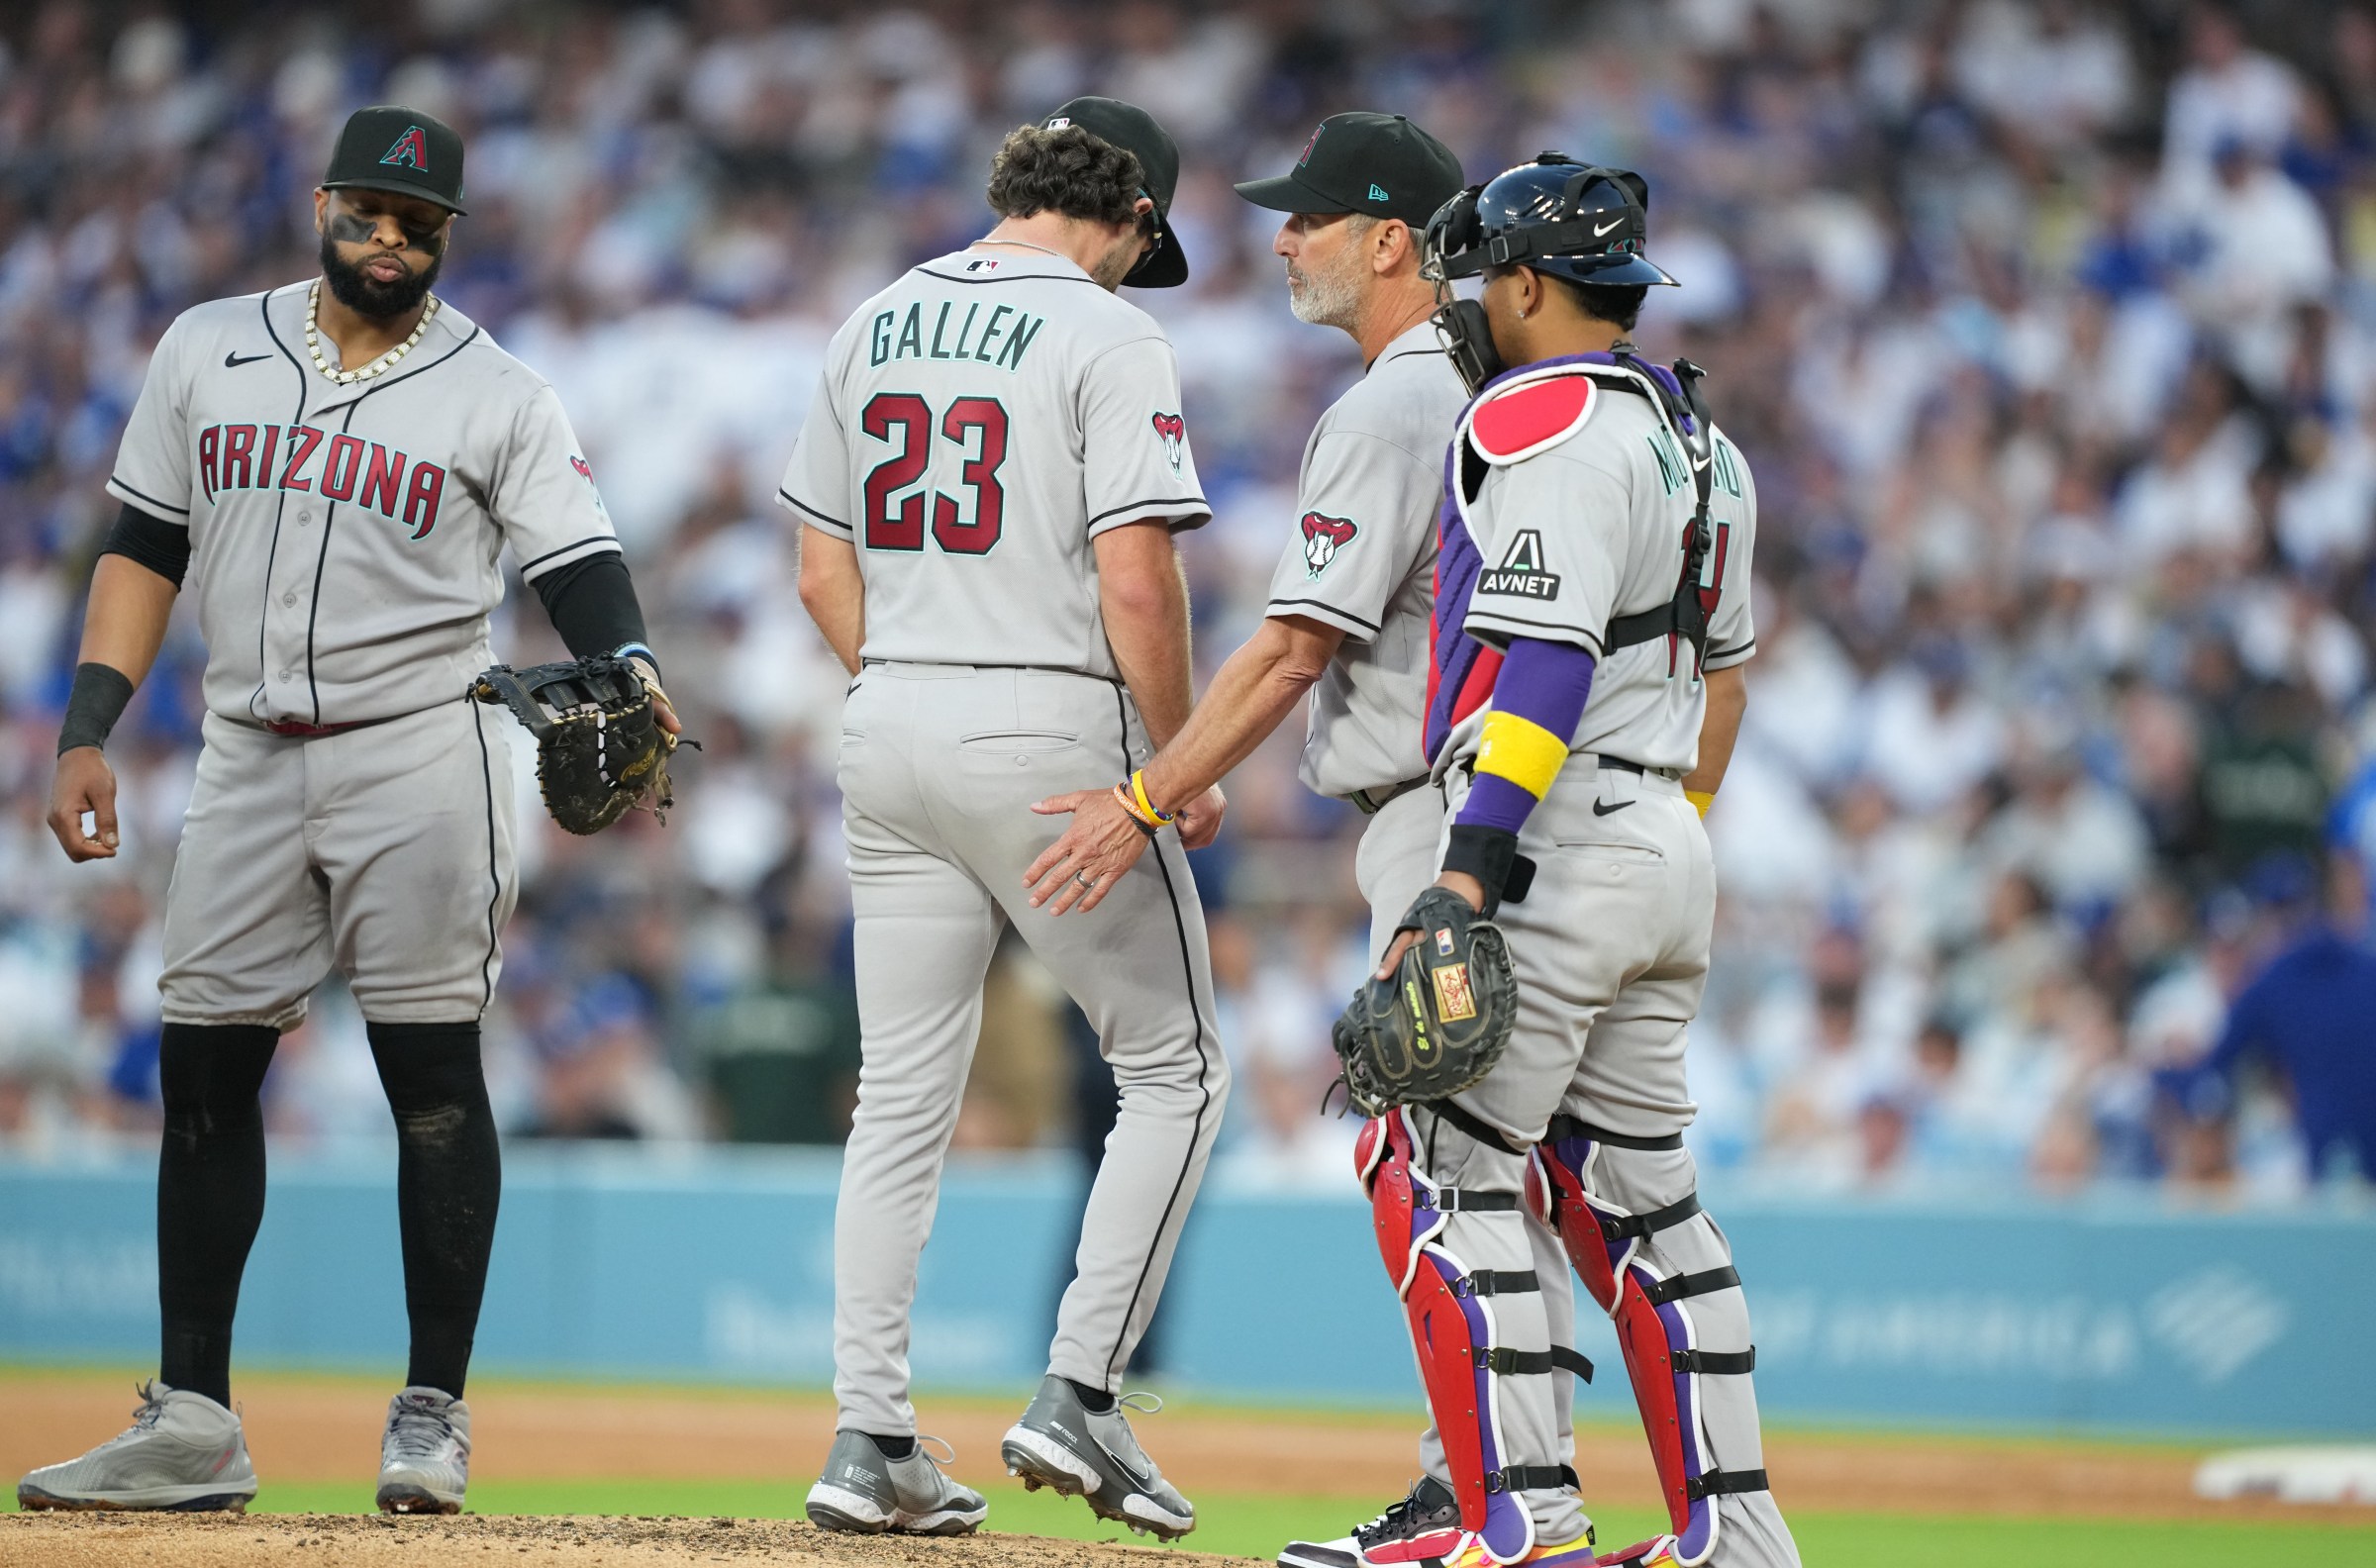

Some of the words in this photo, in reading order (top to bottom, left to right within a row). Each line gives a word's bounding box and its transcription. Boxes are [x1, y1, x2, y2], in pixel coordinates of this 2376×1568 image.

[869, 300, 1046, 374] GALLEN
[198, 423, 447, 540] ARIZONA
[860, 391, 1010, 557] 23
[1482, 573, 1555, 596] AVNET
